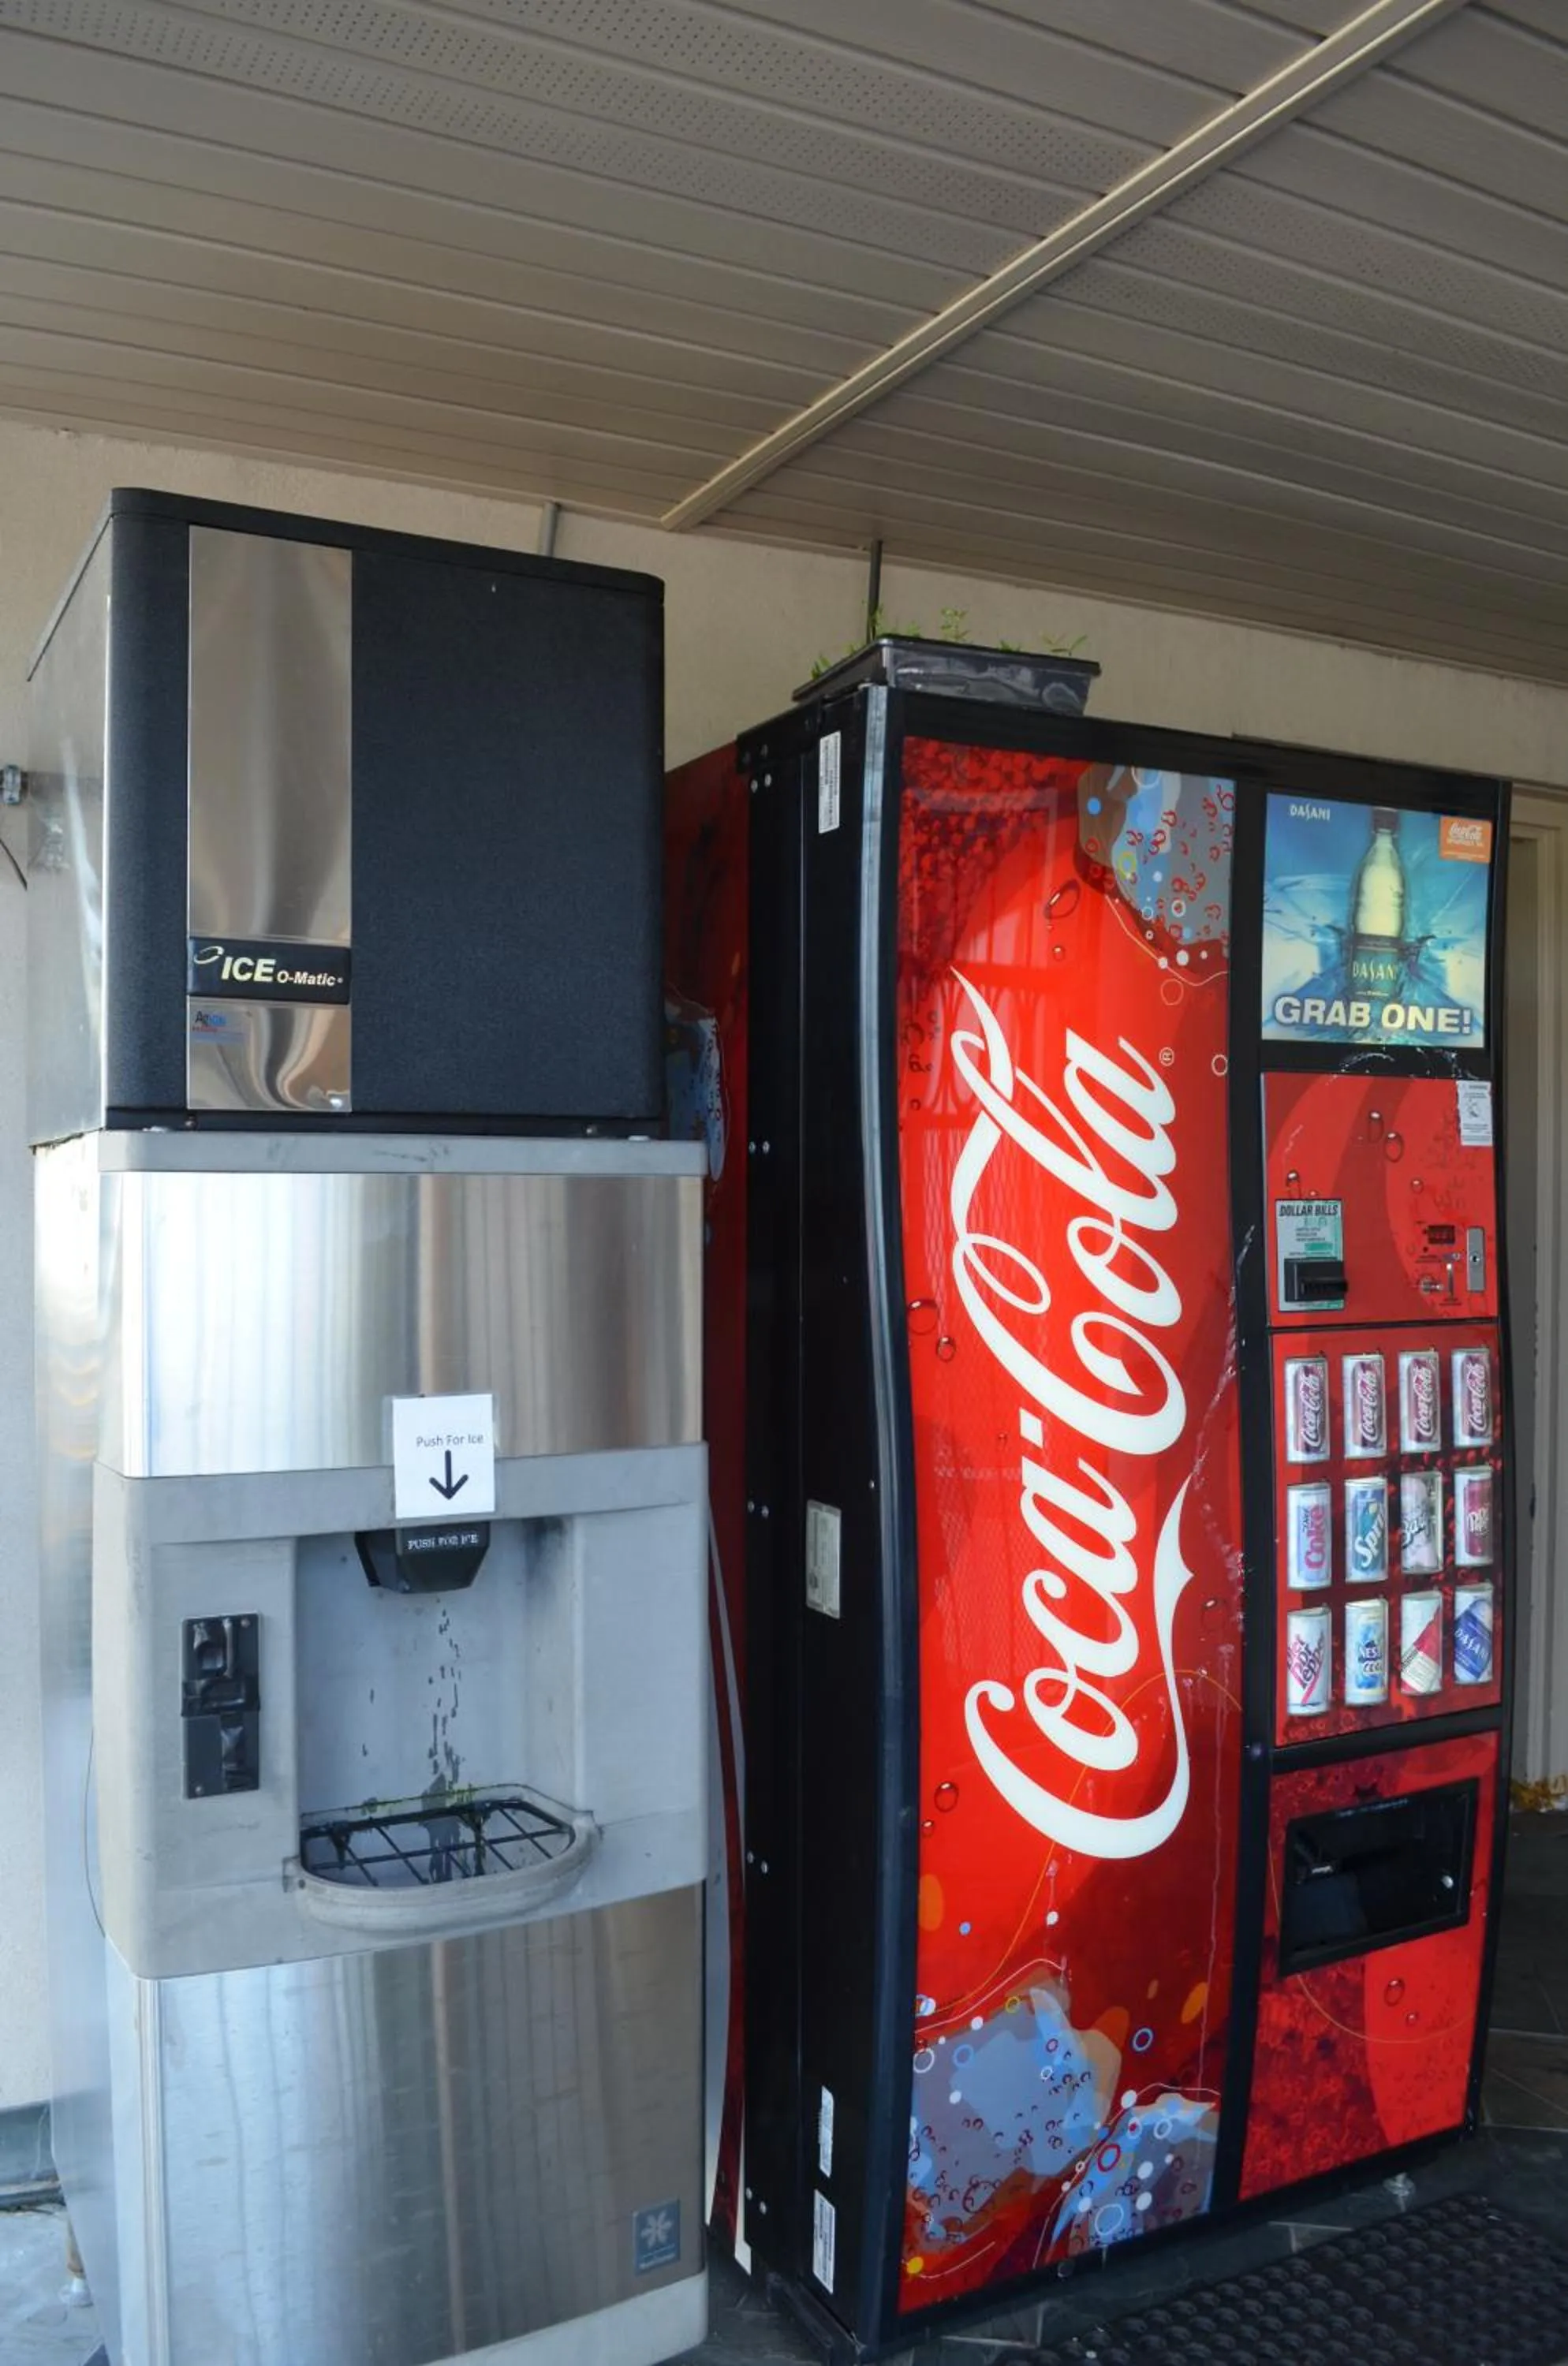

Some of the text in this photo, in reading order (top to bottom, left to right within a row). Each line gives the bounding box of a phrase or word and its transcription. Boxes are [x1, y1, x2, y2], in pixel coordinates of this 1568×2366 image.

[1290, 803, 1331, 822] DASANI
[221, 957, 276, 983] ICE
[1274, 995, 1472, 1036] GRAB ONE!
[1279, 1204, 1339, 1217] DOLLAR BILLS
[950, 968, 1193, 1860] Coca-Cola
[416, 1434, 484, 1447] Push For Ice
[1304, 1503, 1327, 1571] Coke
